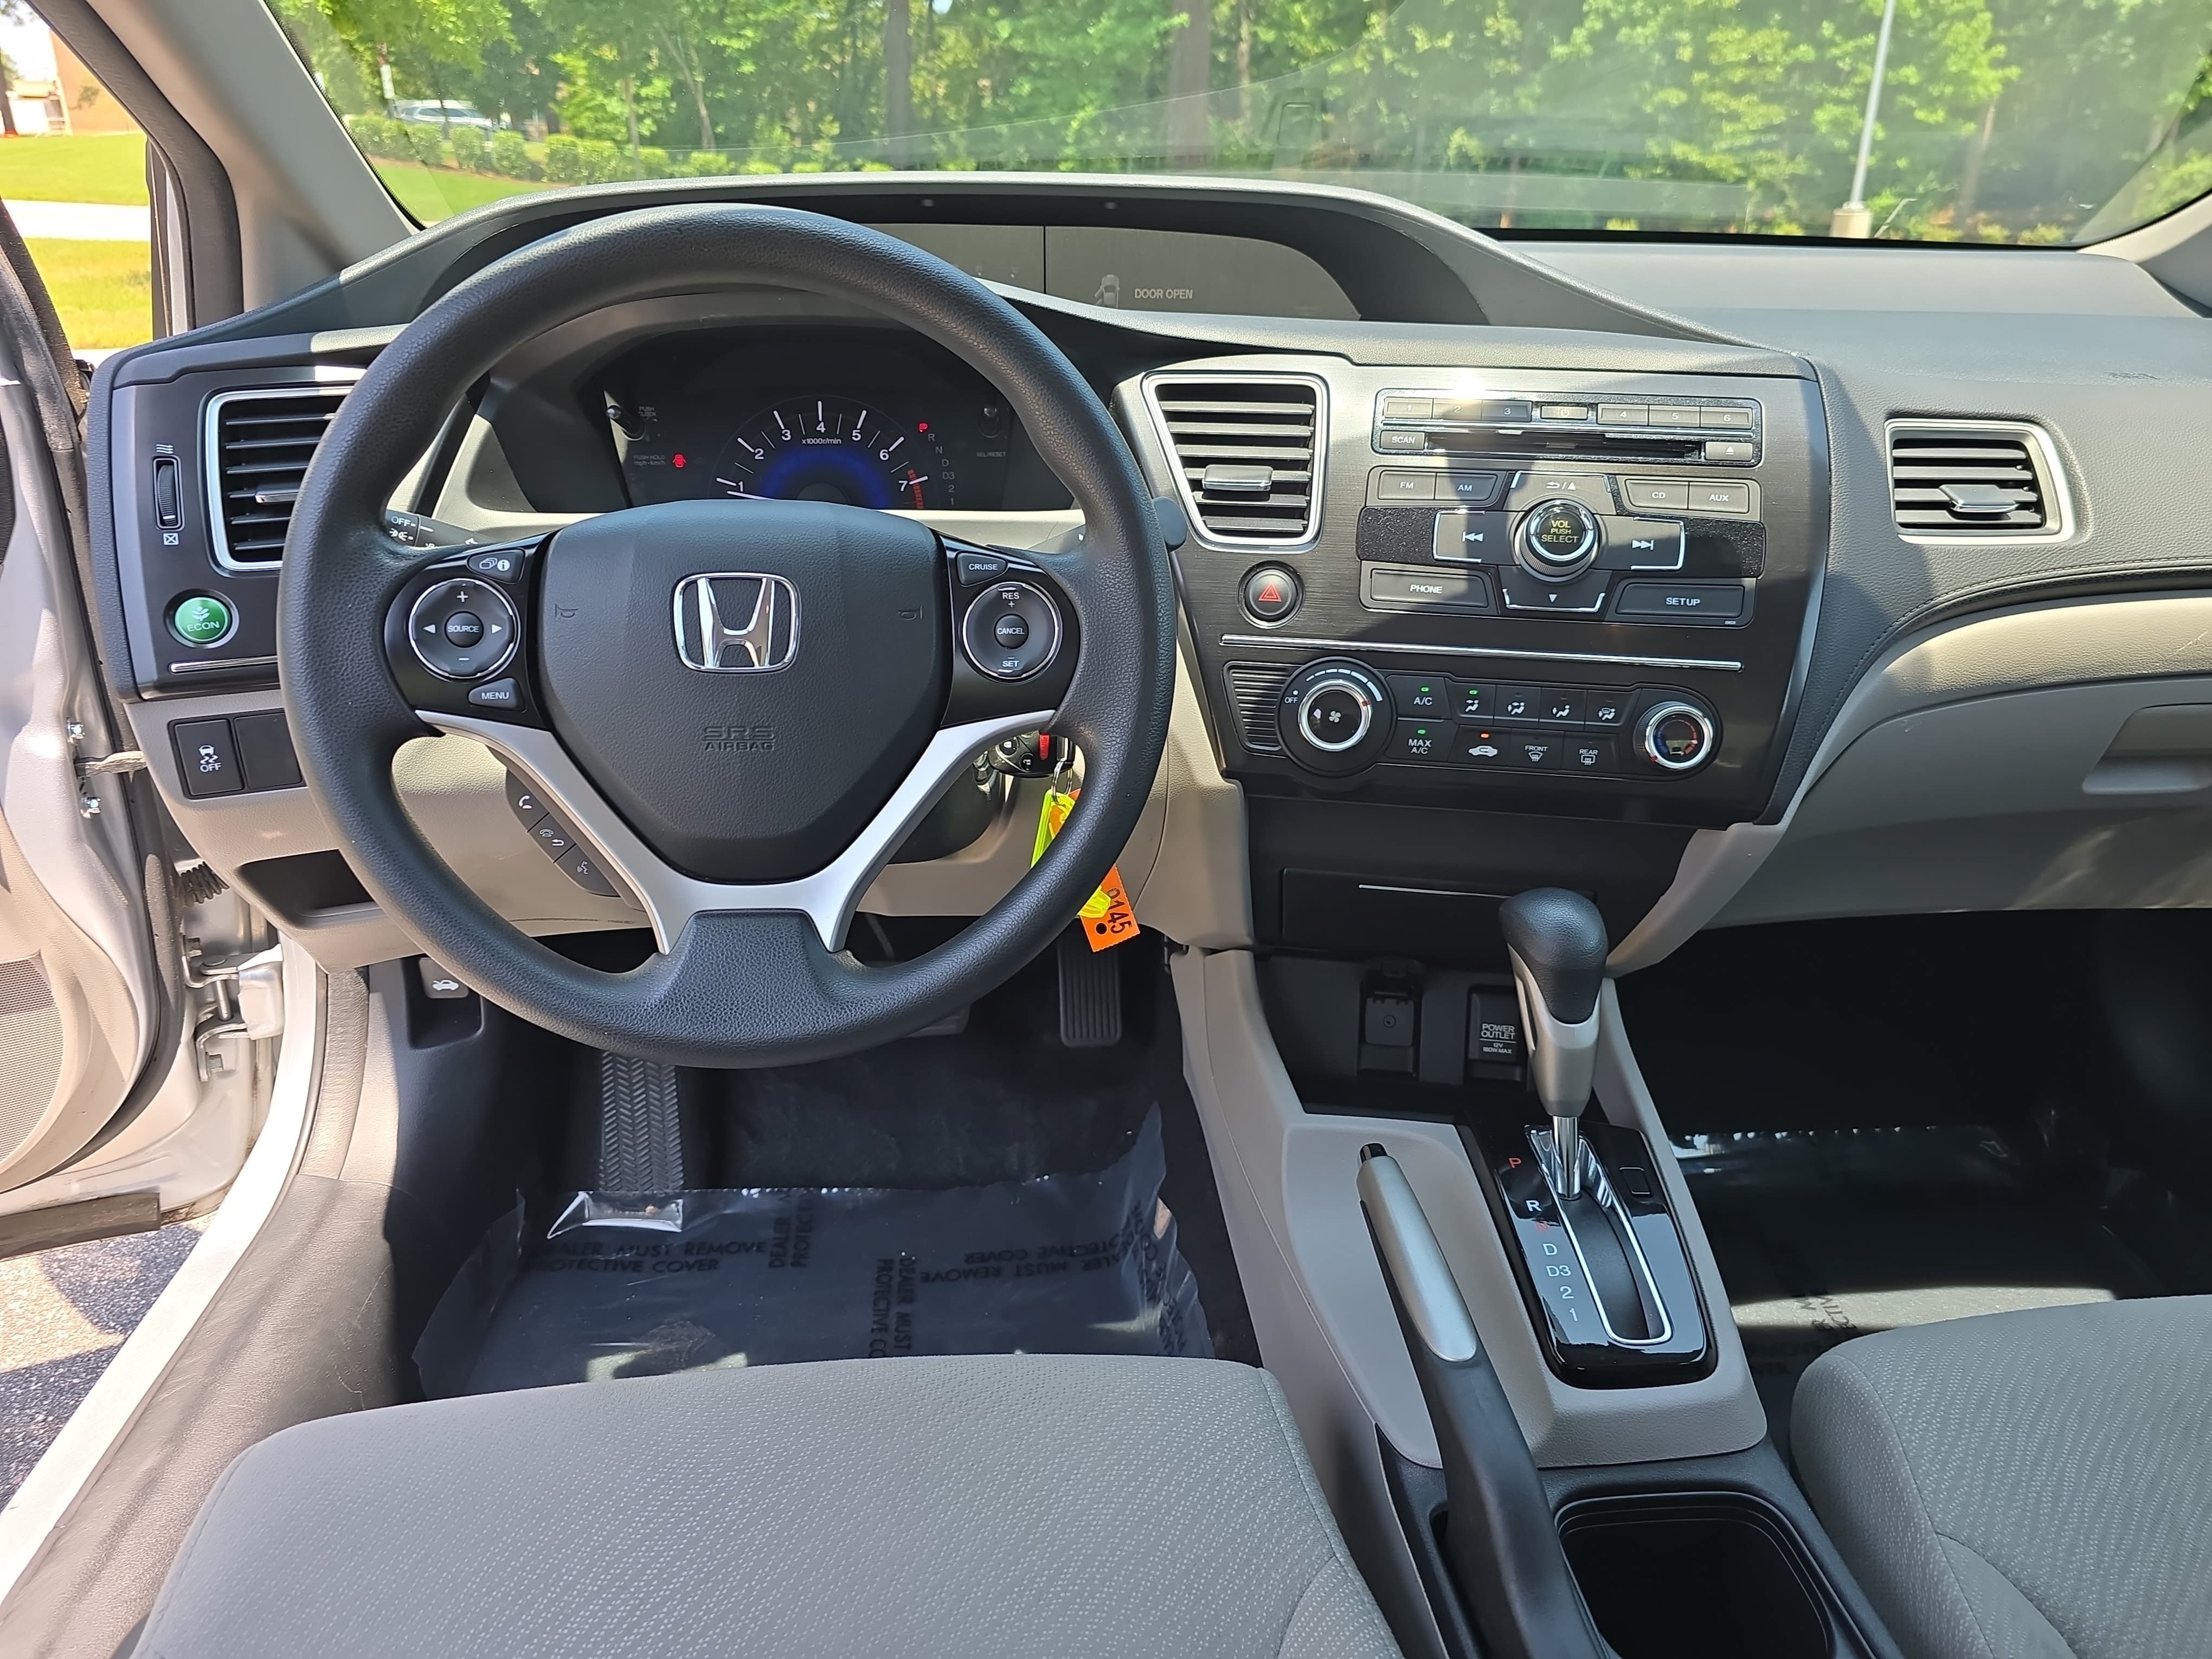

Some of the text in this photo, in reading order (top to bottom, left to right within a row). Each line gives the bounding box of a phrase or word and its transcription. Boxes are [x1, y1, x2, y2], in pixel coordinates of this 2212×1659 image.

[1134, 288, 1193, 299] DOOR OPEN
[815, 421, 826, 433] 4
[918, 423, 928, 433] P
[781, 429, 792, 441] 3
[851, 429, 861, 441] 5
[928, 433, 935, 441] R
[754, 448, 764, 460] 2
[879, 449, 890, 461] 6
[935, 446, 943, 454] N
[941, 459, 949, 467] D
[942, 471, 955, 480] D3
[738, 480, 744, 492] 1
[898, 480, 908, 492] 7
[948, 485, 955, 493] 2
[390, 516, 411, 527] OFF
[1551, 520, 1571, 528] VOL
[1541, 534, 1579, 543] SELECT
[968, 563, 999, 571] CRUISE
[1410, 584, 1443, 594] PHONE
[1002, 592, 1020, 600] RES
[1666, 597, 1701, 607] SETUP
[187, 619, 221, 633] ECON
[447, 625, 480, 633] SOURCE
[996, 627, 1025, 635] CANCEL
[481, 691, 510, 699] MENU
[1413, 697, 1433, 706] A/C
[704, 741, 775, 751] AIRBAG
[1407, 738, 1432, 748] MAX
[1411, 747, 1428, 755] A/C
[199, 761, 222, 773] OFF
[1107, 888, 1133, 934] 0145
[1482, 1023, 1515, 1033] POWER
[1481, 1030, 1515, 1040] OUTLET
[1508, 1158, 1522, 1168] P
[1526, 1199, 1543, 1212] R
[768, 1215, 790, 1269] DEALER
[684, 1240, 768, 1256] REMOVE
[963, 1233, 1121, 1265] OTECTIVE COVER
[1542, 1243, 1558, 1256] D
[652, 1258, 721, 1273] COVER
[1013, 1260, 1068, 1277] MUST
[1546, 1265, 1572, 1277] D3
[919, 1265, 1001, 1284] REMOVE
[1560, 1286, 1574, 1300] 2
[892, 1257, 916, 1351] DEALER MUST
[1568, 1308, 1578, 1322] 1
